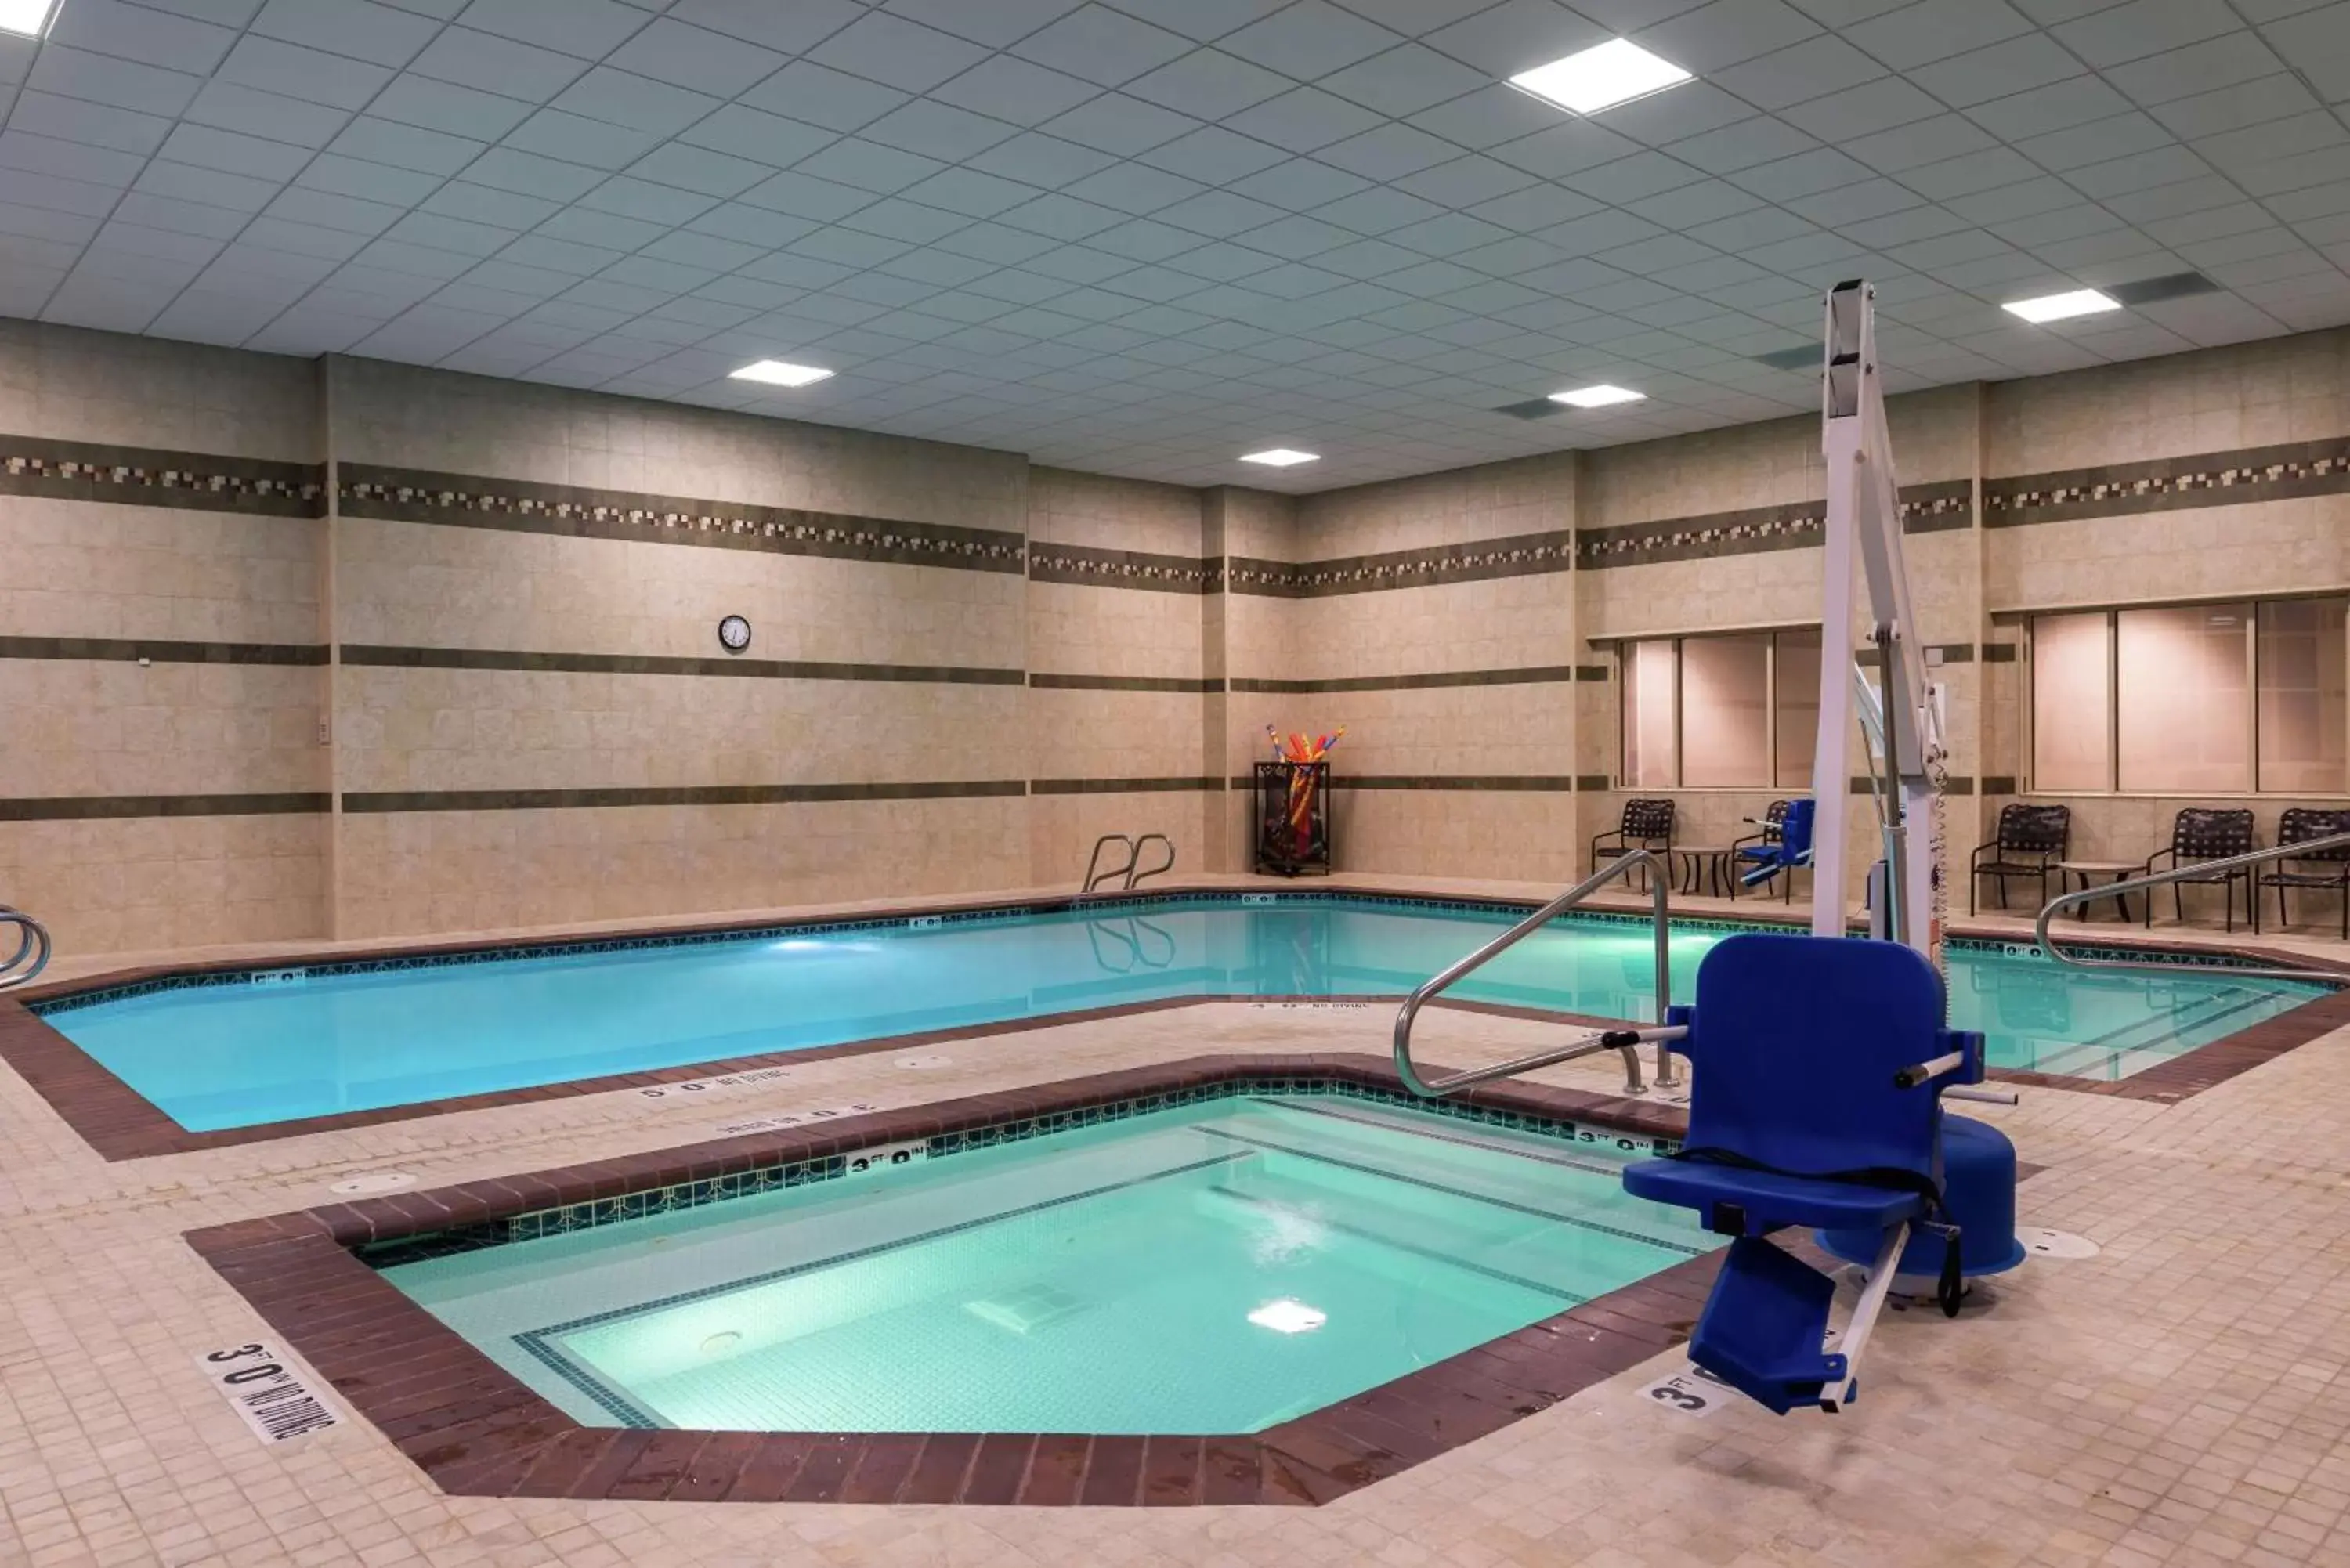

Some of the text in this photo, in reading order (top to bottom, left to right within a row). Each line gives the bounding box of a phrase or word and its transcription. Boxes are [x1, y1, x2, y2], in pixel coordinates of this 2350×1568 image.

[1579, 1132, 1595, 1143] 3
[1616, 1139, 1635, 1150] 0
[852, 1146, 924, 1172] 3 FT 0 IN
[208, 1343, 263, 1362] 3
[223, 1364, 283, 1384] 0
[240, 1382, 306, 1406] NO
[1652, 1377, 1707, 1410] 3 FT
[253, 1396, 335, 1440] DIVING
